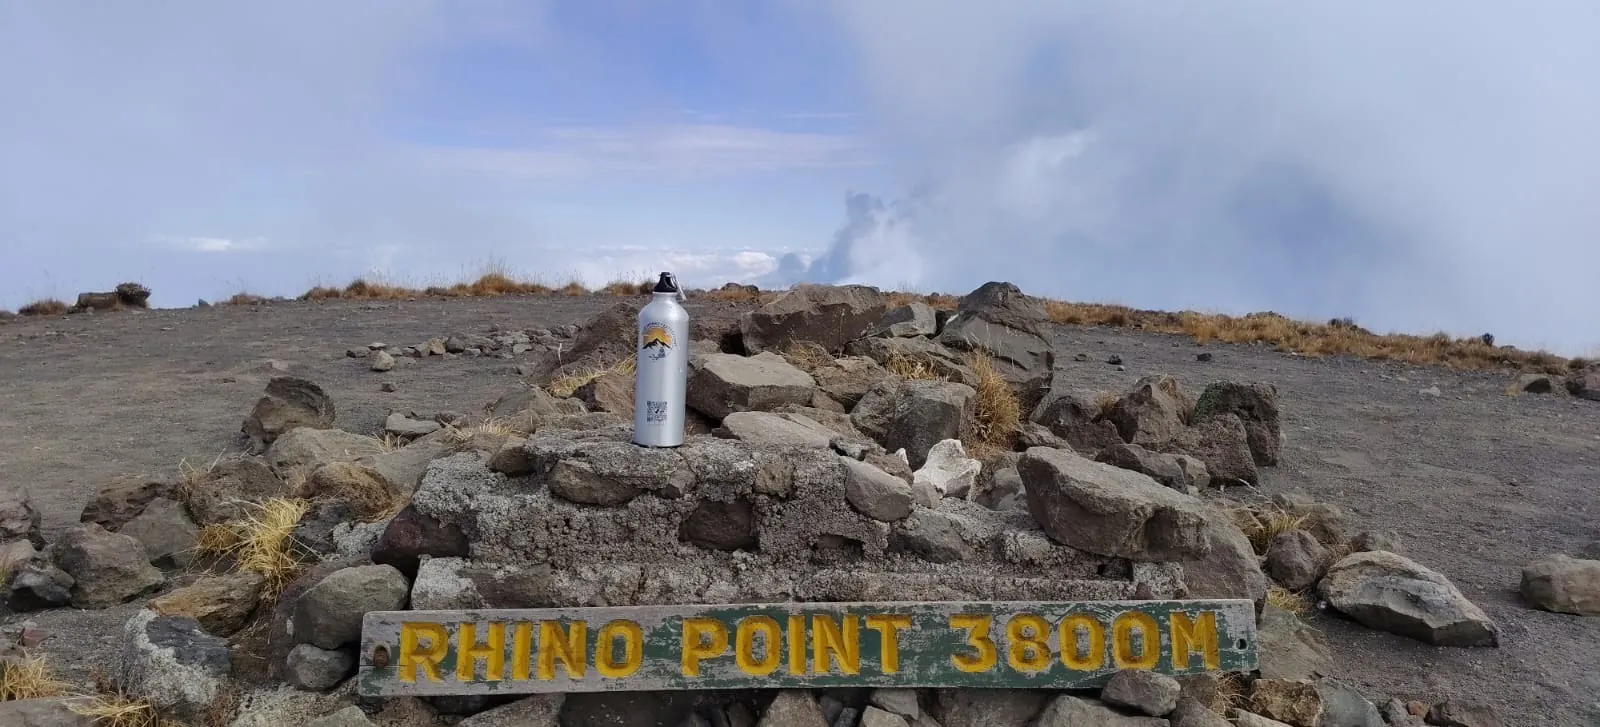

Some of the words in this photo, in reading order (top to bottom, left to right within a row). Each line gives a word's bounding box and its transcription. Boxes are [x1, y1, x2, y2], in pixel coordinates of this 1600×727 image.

[400, 619, 643, 682] RHINO
[683, 614, 911, 676] POINT
[950, 612, 1220, 673] 3800M
